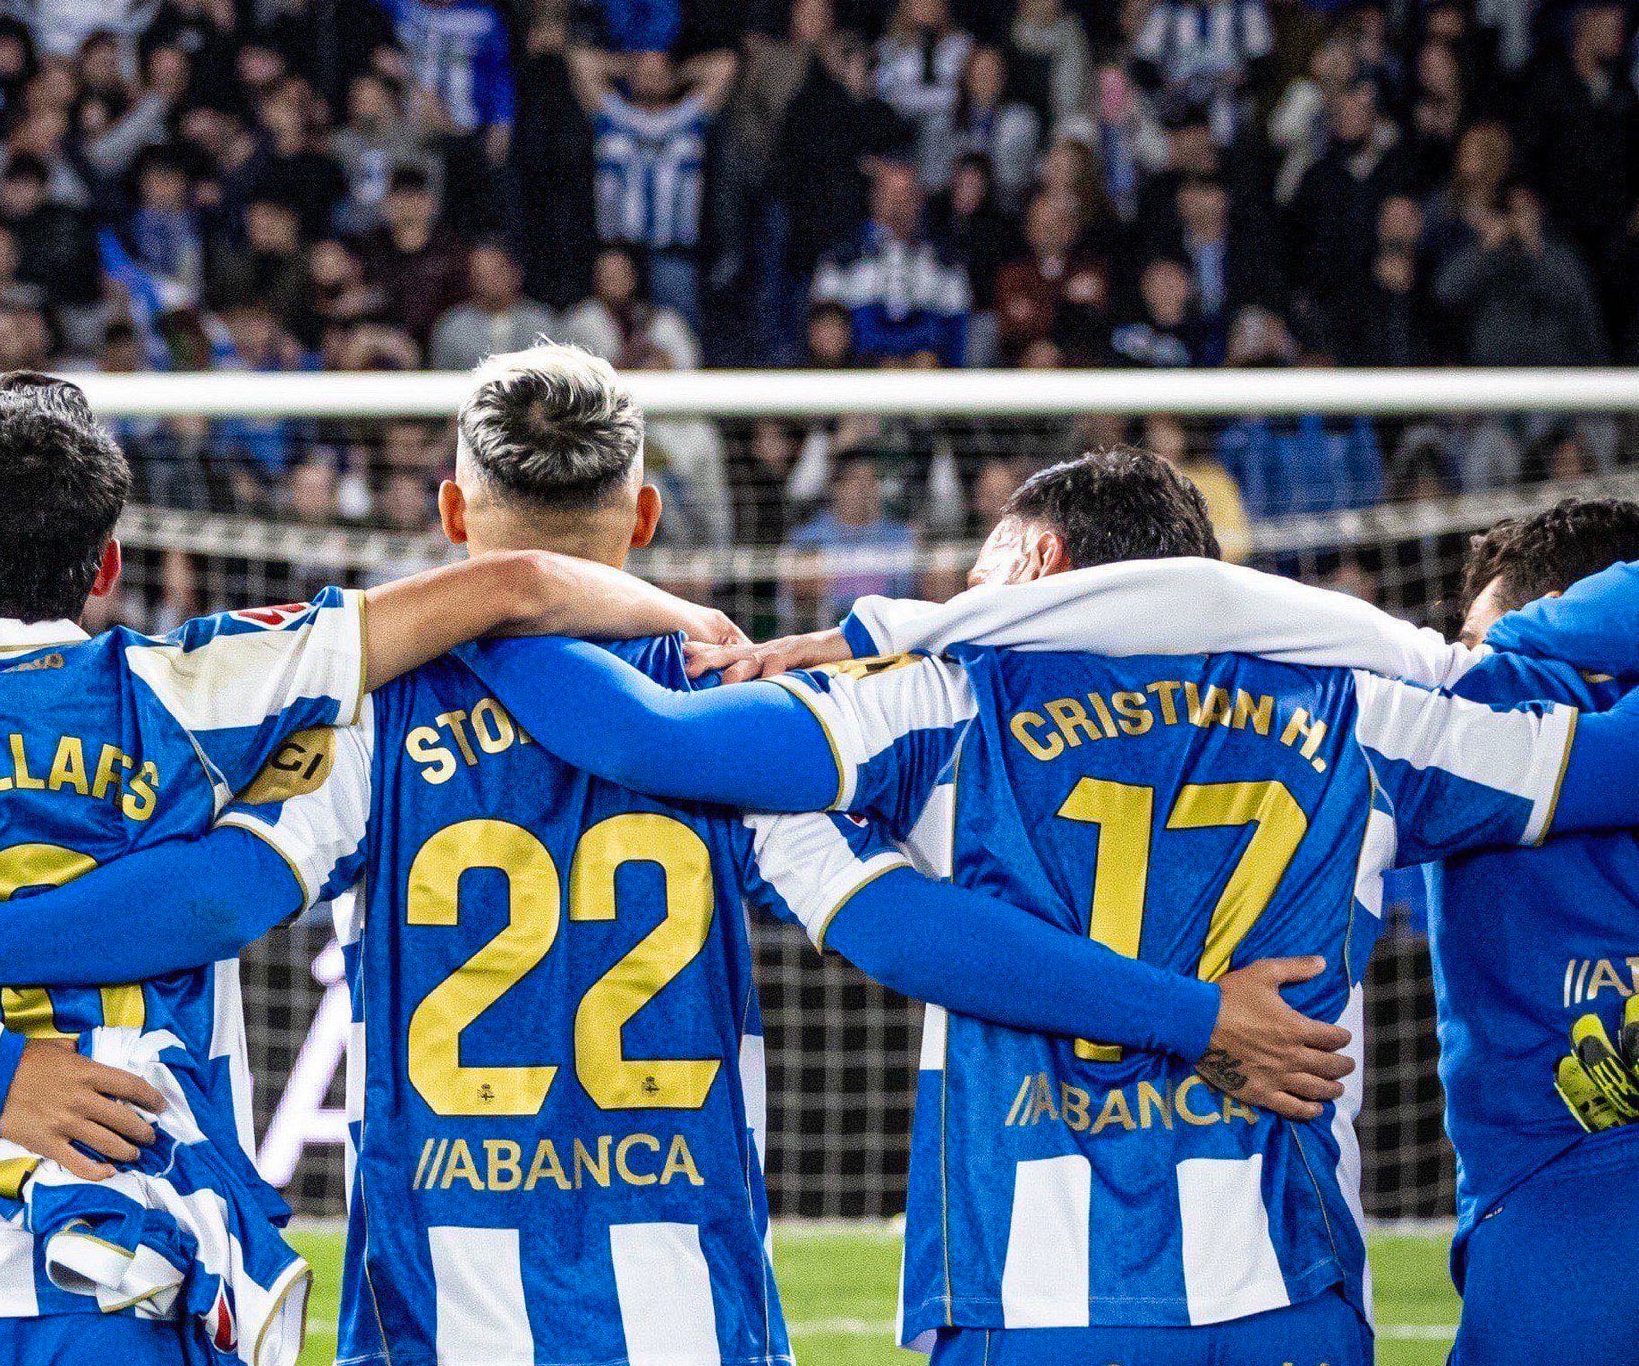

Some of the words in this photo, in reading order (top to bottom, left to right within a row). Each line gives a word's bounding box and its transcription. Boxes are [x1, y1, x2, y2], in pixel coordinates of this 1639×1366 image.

[405, 697, 532, 786] STO
[1279, 706, 1328, 774] H.
[405, 811, 723, 1117] 22
[1055, 776, 1309, 1064] 17
